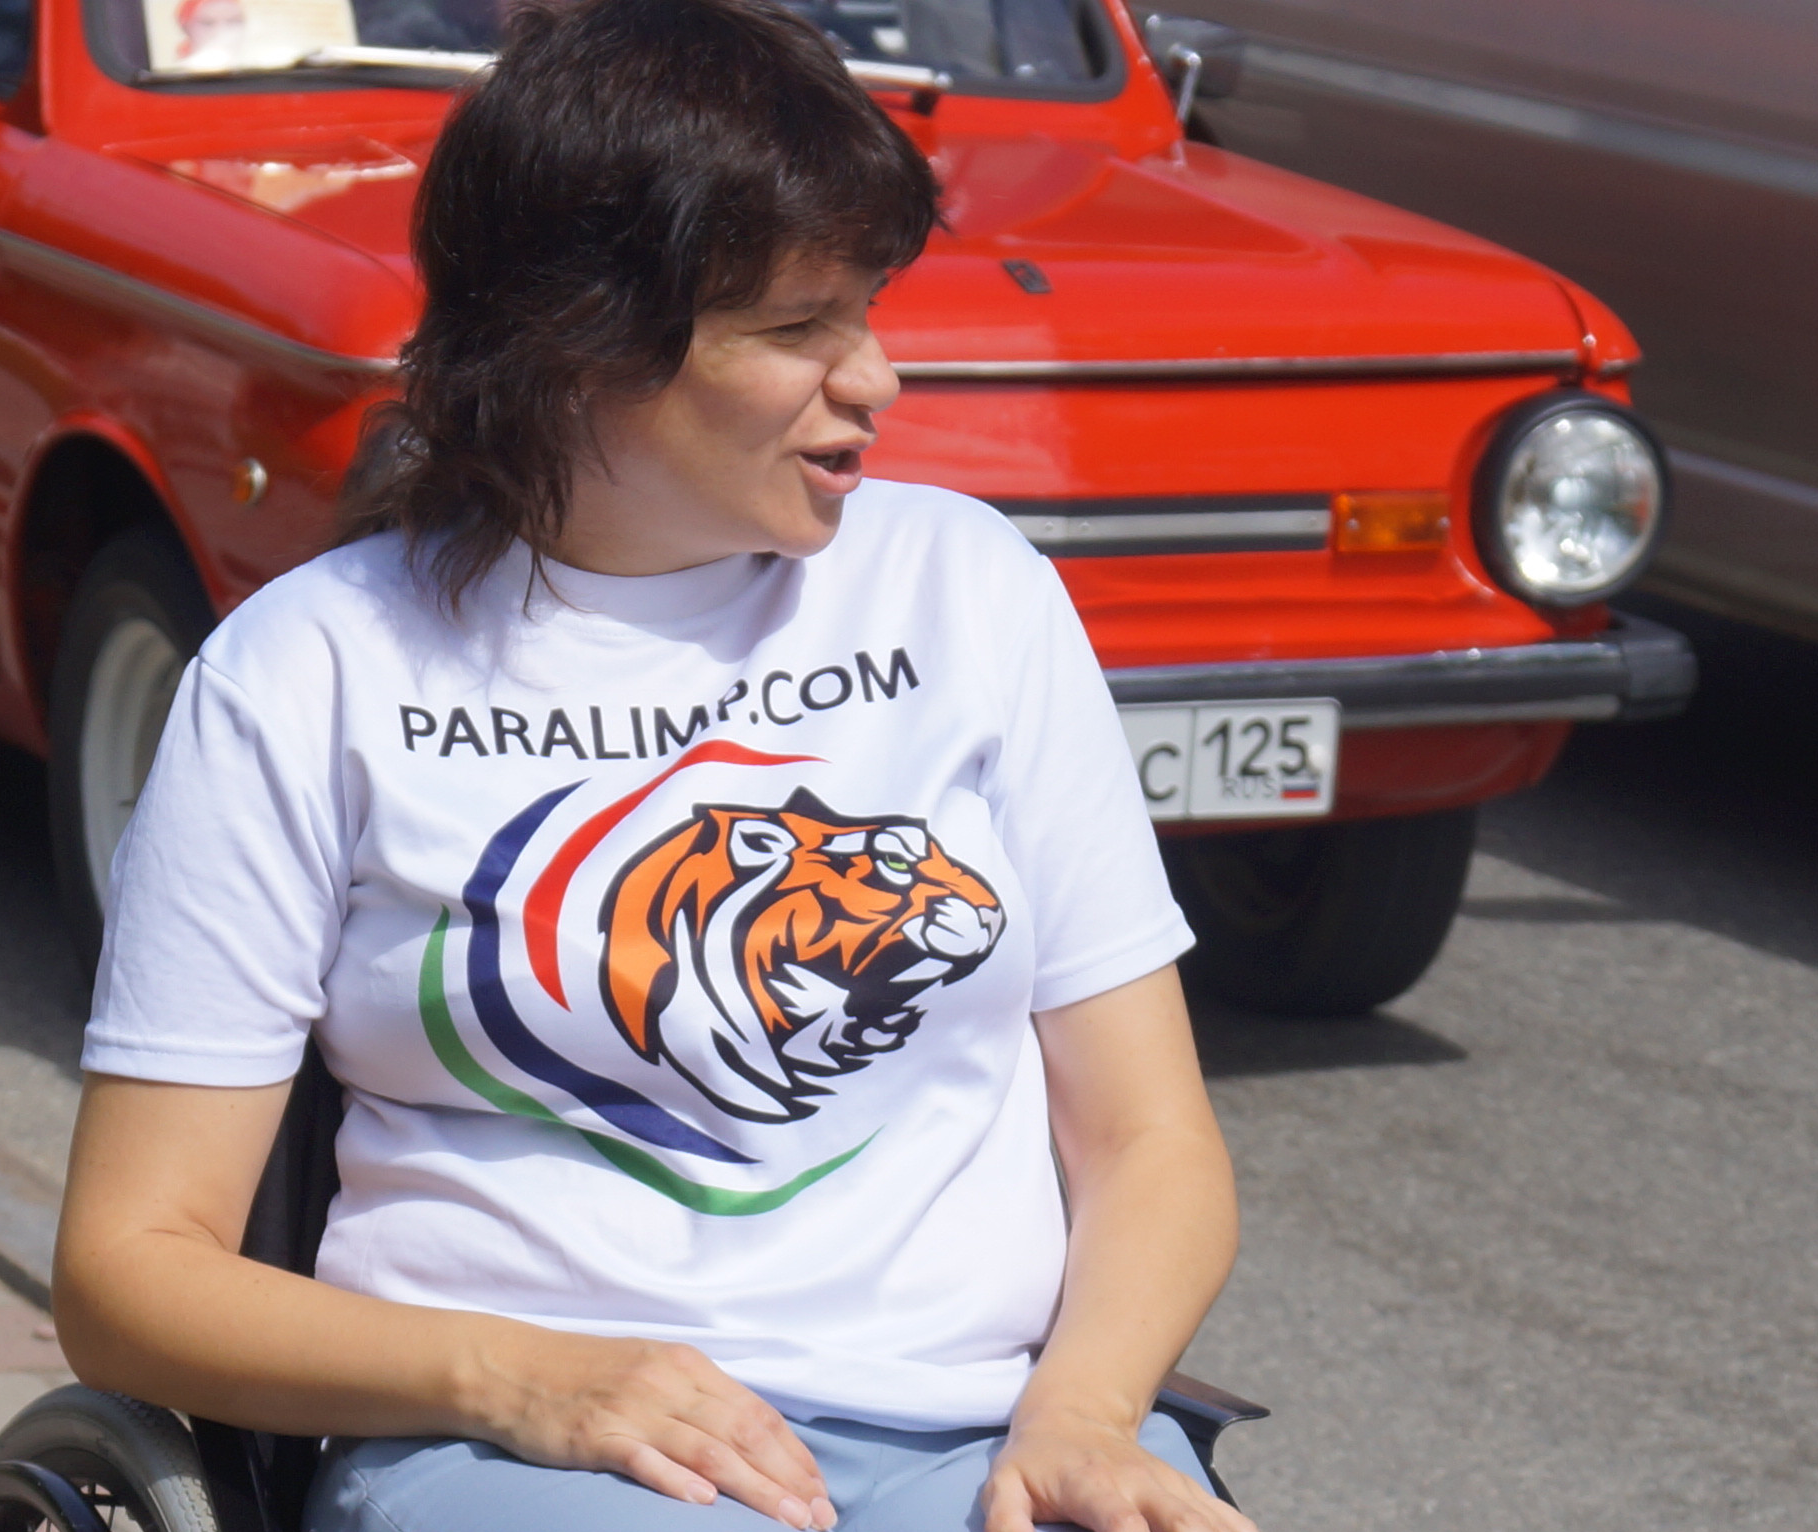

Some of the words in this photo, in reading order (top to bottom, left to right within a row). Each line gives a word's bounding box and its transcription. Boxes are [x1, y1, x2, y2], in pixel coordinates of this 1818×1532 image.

[398, 647, 921, 760] PARALIMP.COM
[1204, 715, 1311, 778] 125
[1221, 777, 1278, 799] RUS
